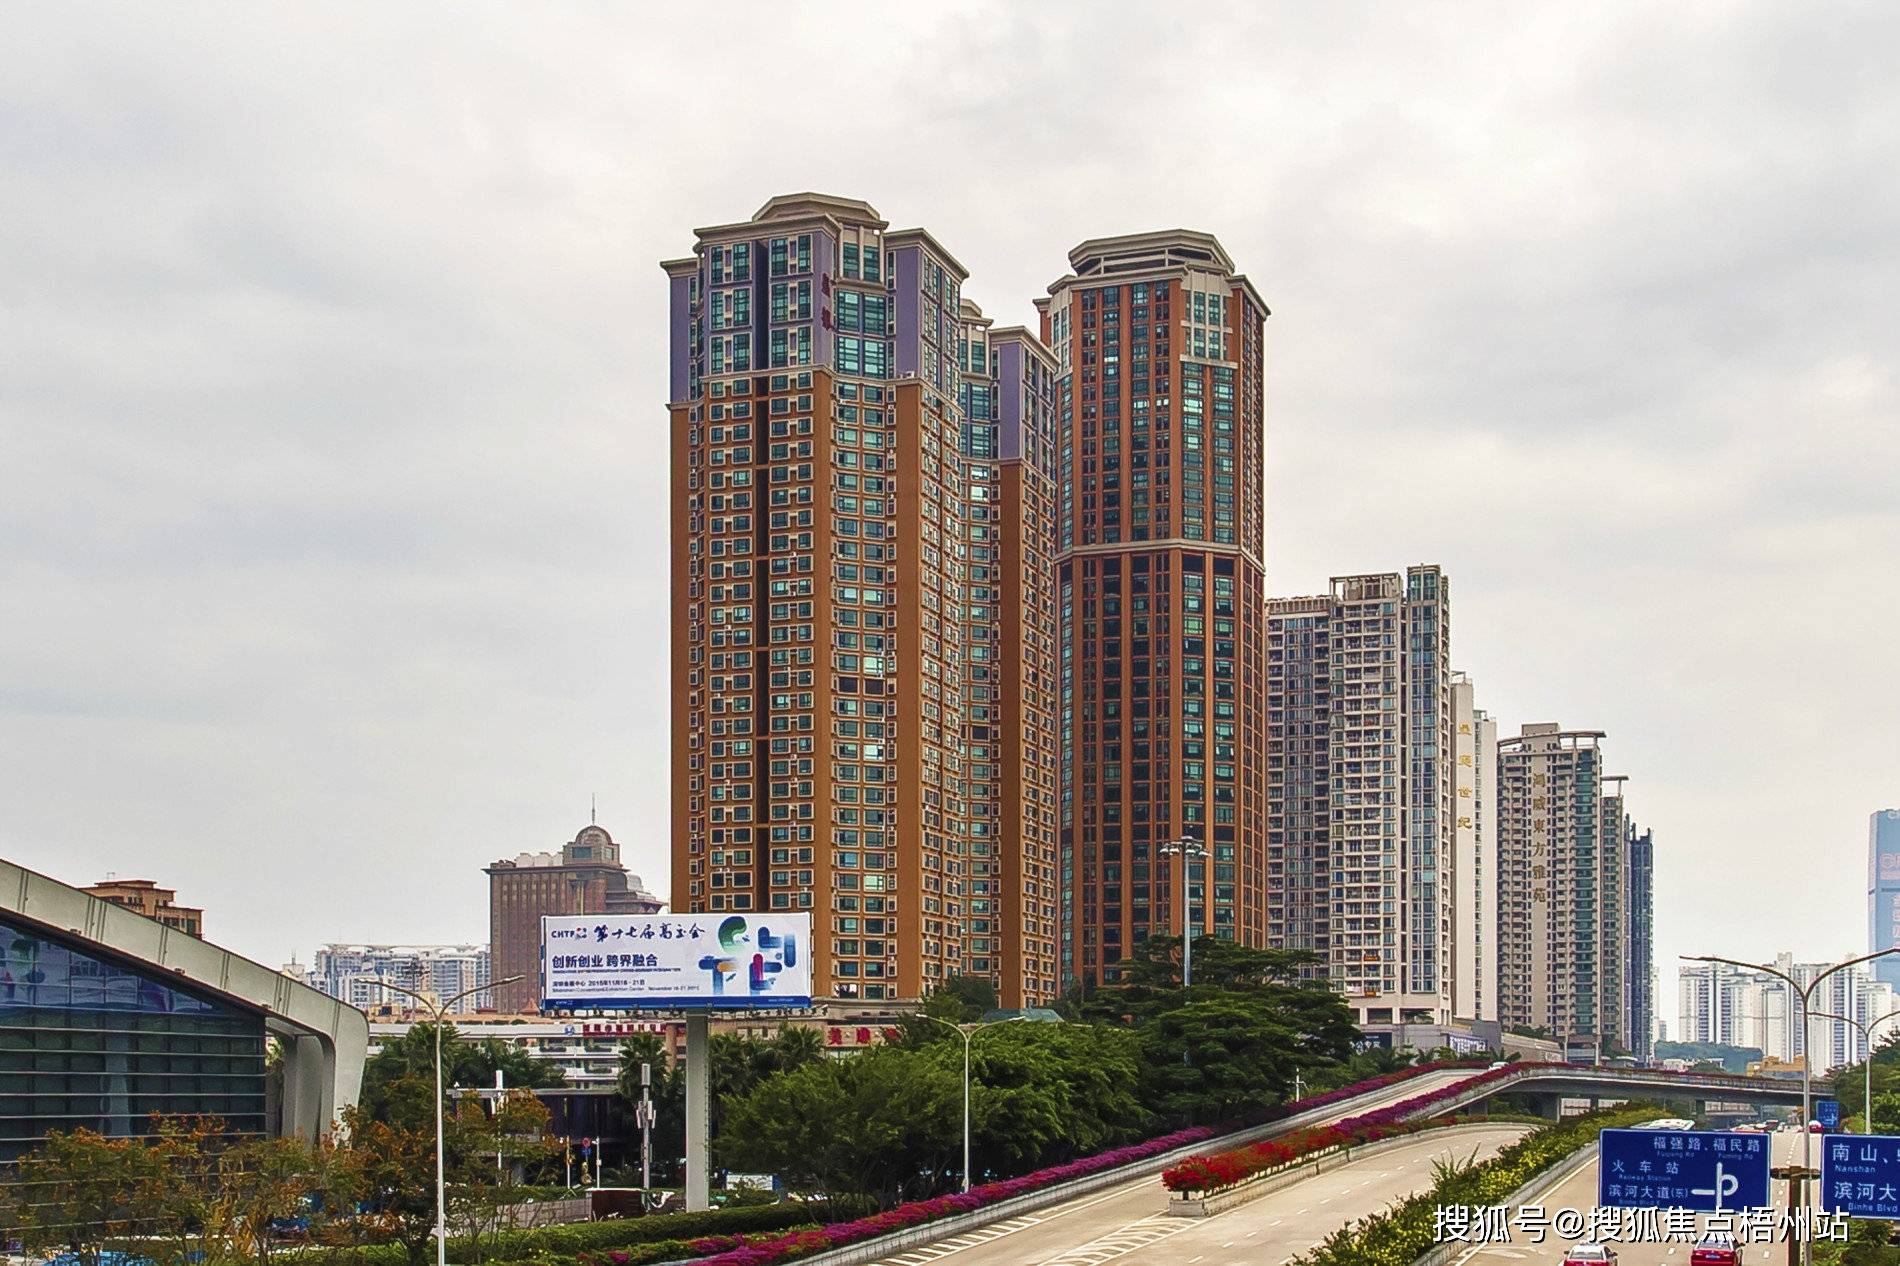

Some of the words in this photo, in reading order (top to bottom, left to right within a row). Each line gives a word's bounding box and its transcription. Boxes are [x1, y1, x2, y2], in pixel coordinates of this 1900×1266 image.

[552, 955, 603, 968] 创新创业
[606, 954, 658, 967] 跨界融合
[1612, 1159, 1680, 1175] 火车站
[1835, 1165, 1876, 1173] Nanshan
[1848, 1202, 1873, 1211] Binhe
[1877, 1203, 1898, 1212] Blvd
